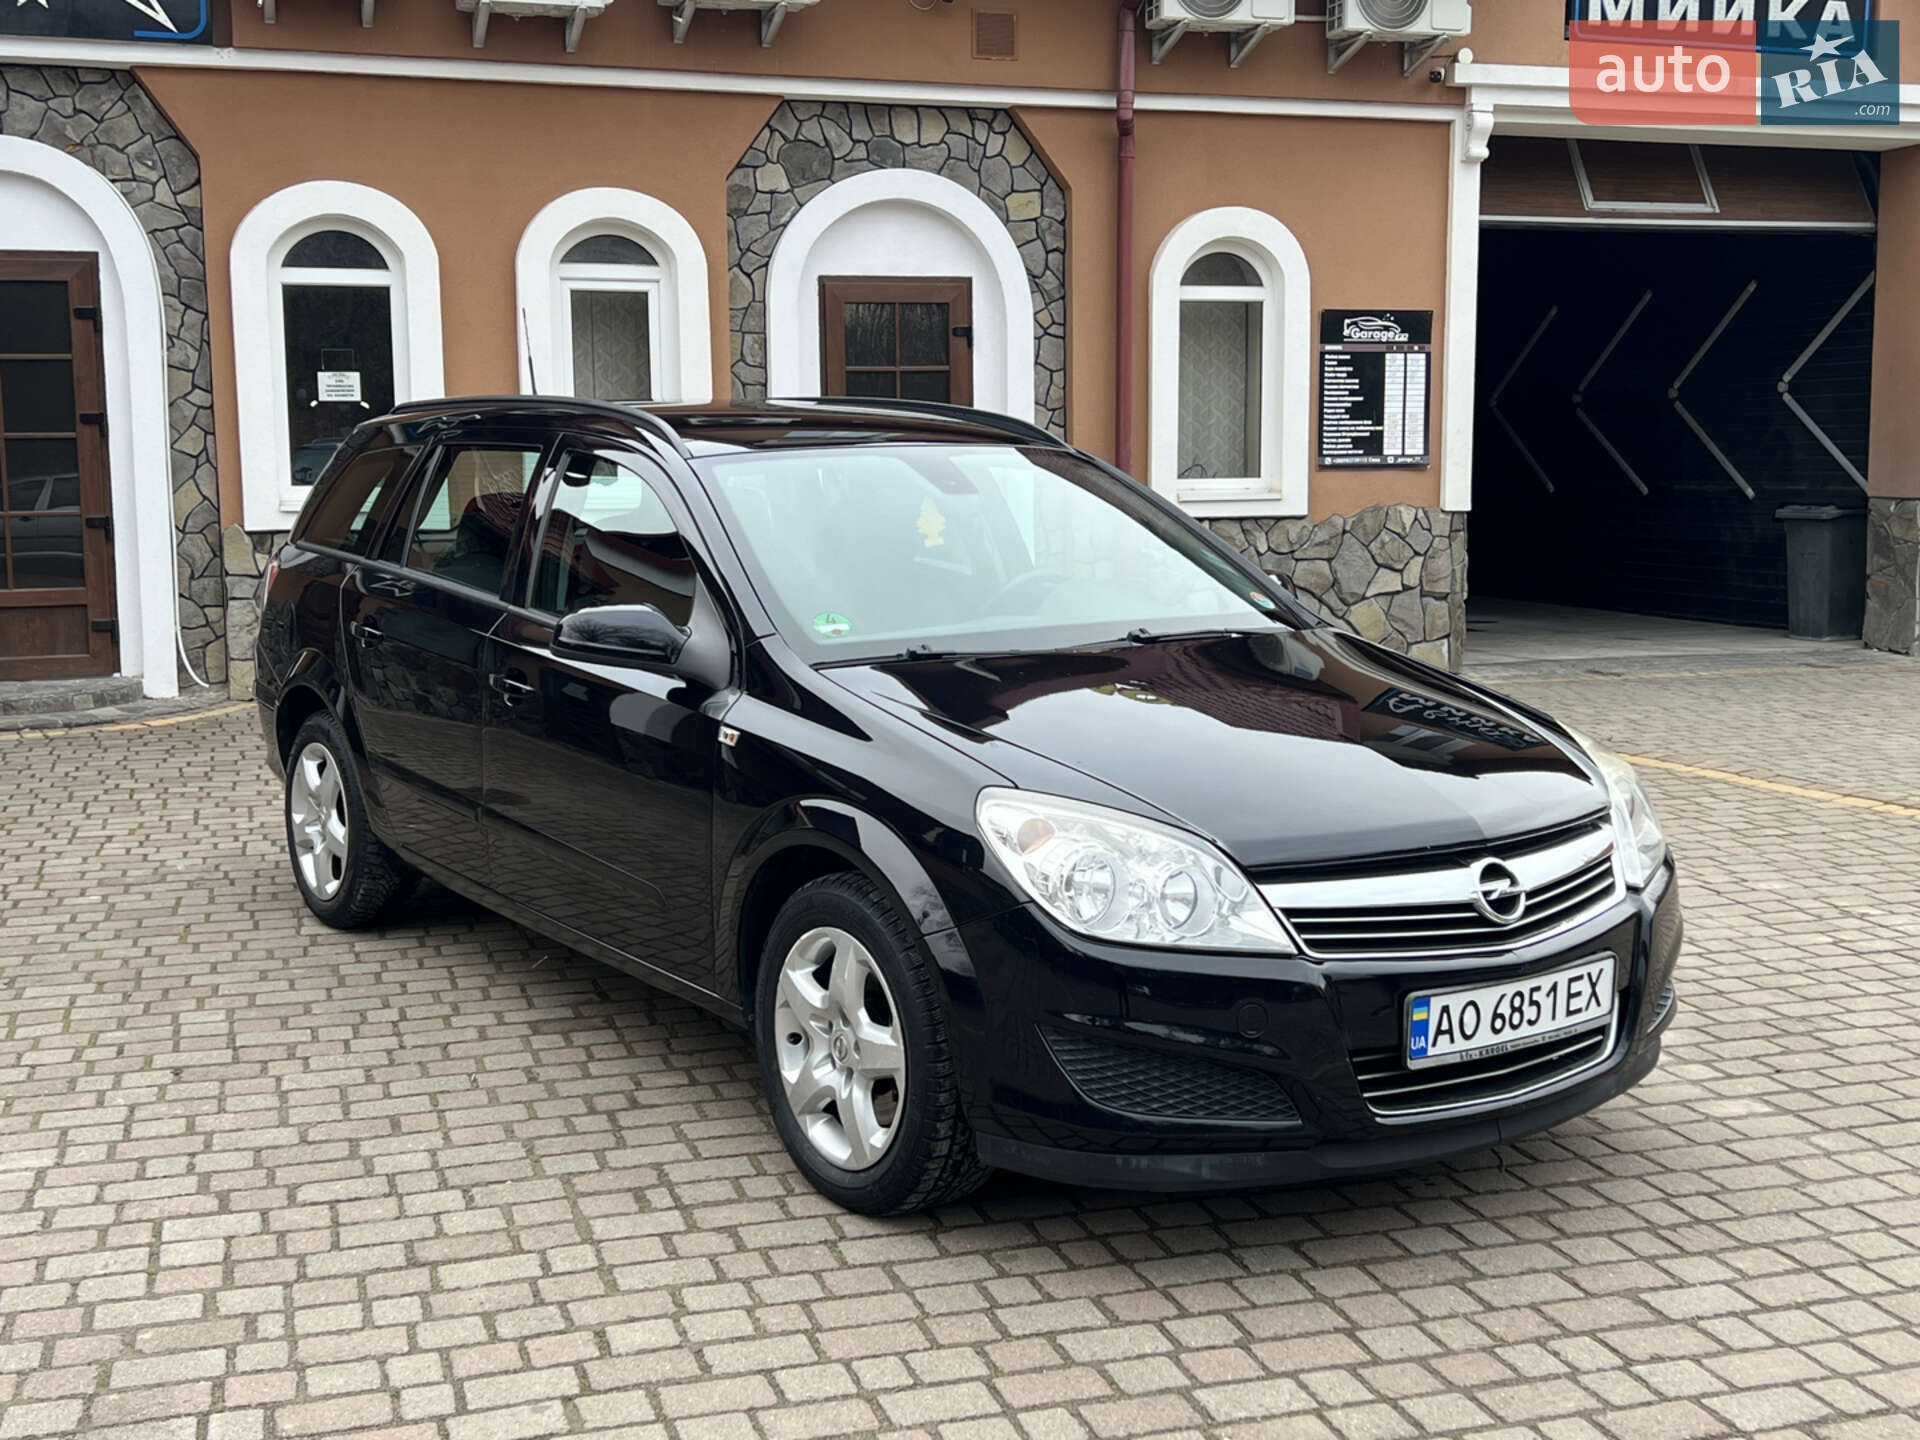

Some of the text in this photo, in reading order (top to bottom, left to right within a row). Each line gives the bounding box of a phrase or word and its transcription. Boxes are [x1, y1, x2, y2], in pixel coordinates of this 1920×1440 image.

[1350, 327, 1395, 342] Garage
[1431, 1000, 1481, 1048] AO
[1490, 981, 1559, 1035] 6851
[1565, 968, 1604, 1018] EX
[1411, 1037, 1426, 1050] UA
